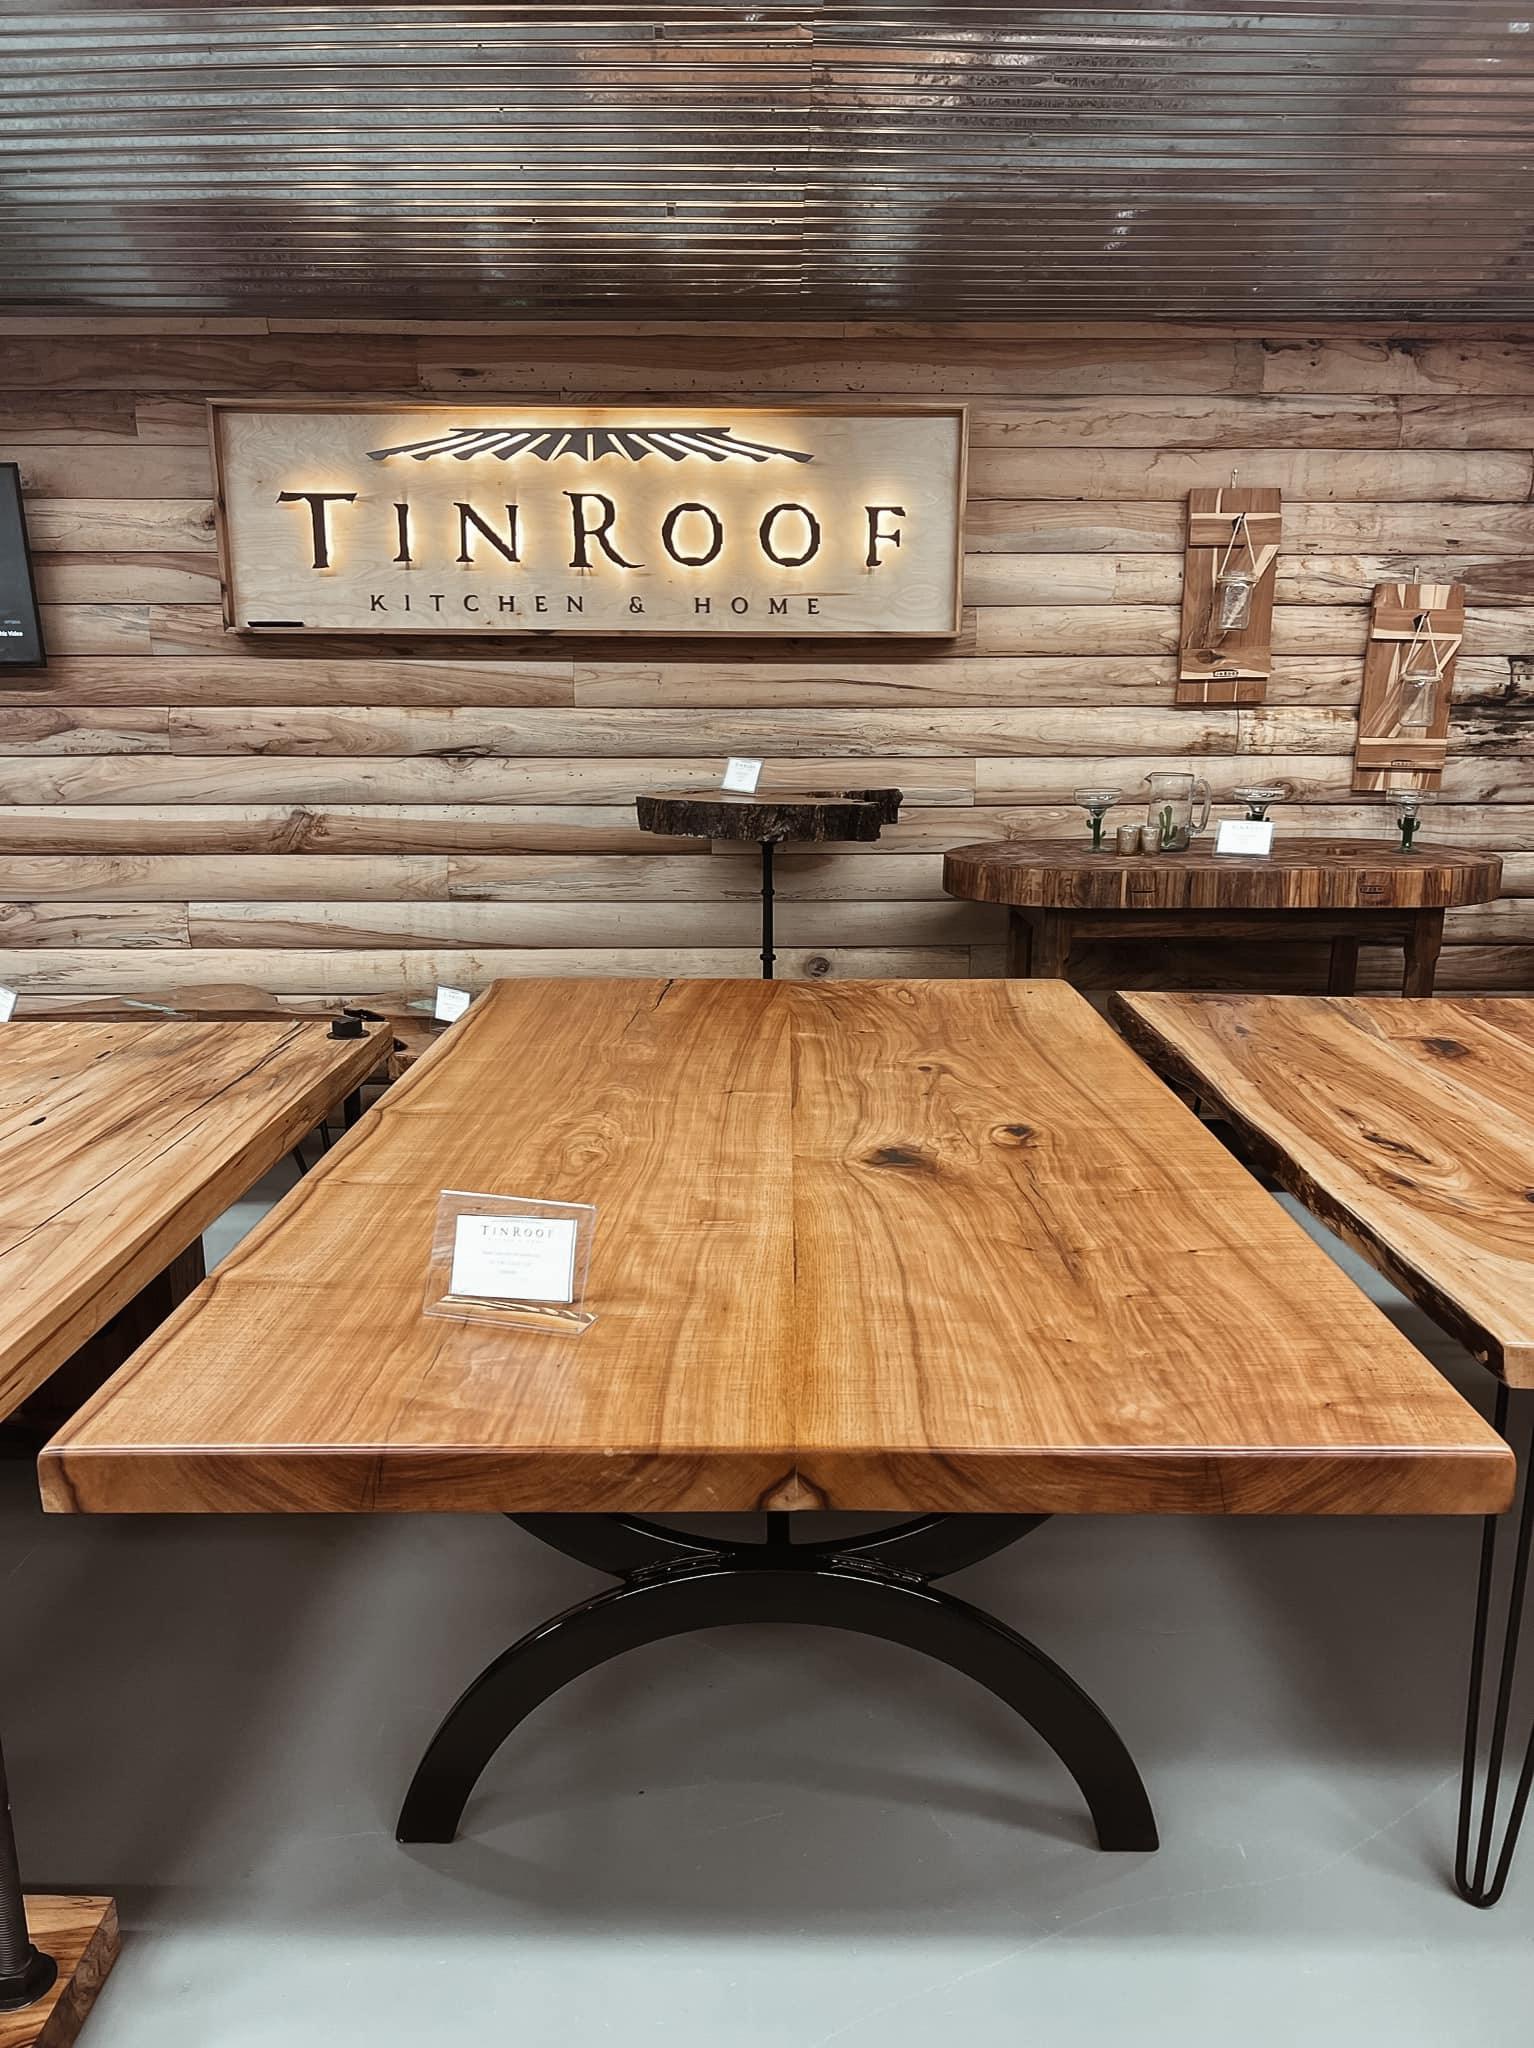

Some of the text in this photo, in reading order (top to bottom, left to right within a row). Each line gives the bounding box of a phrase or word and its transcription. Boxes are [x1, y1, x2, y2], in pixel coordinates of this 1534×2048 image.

[276, 490, 906, 571] TINROOF
[370, 594, 820, 615] KITCHEN & HOME
